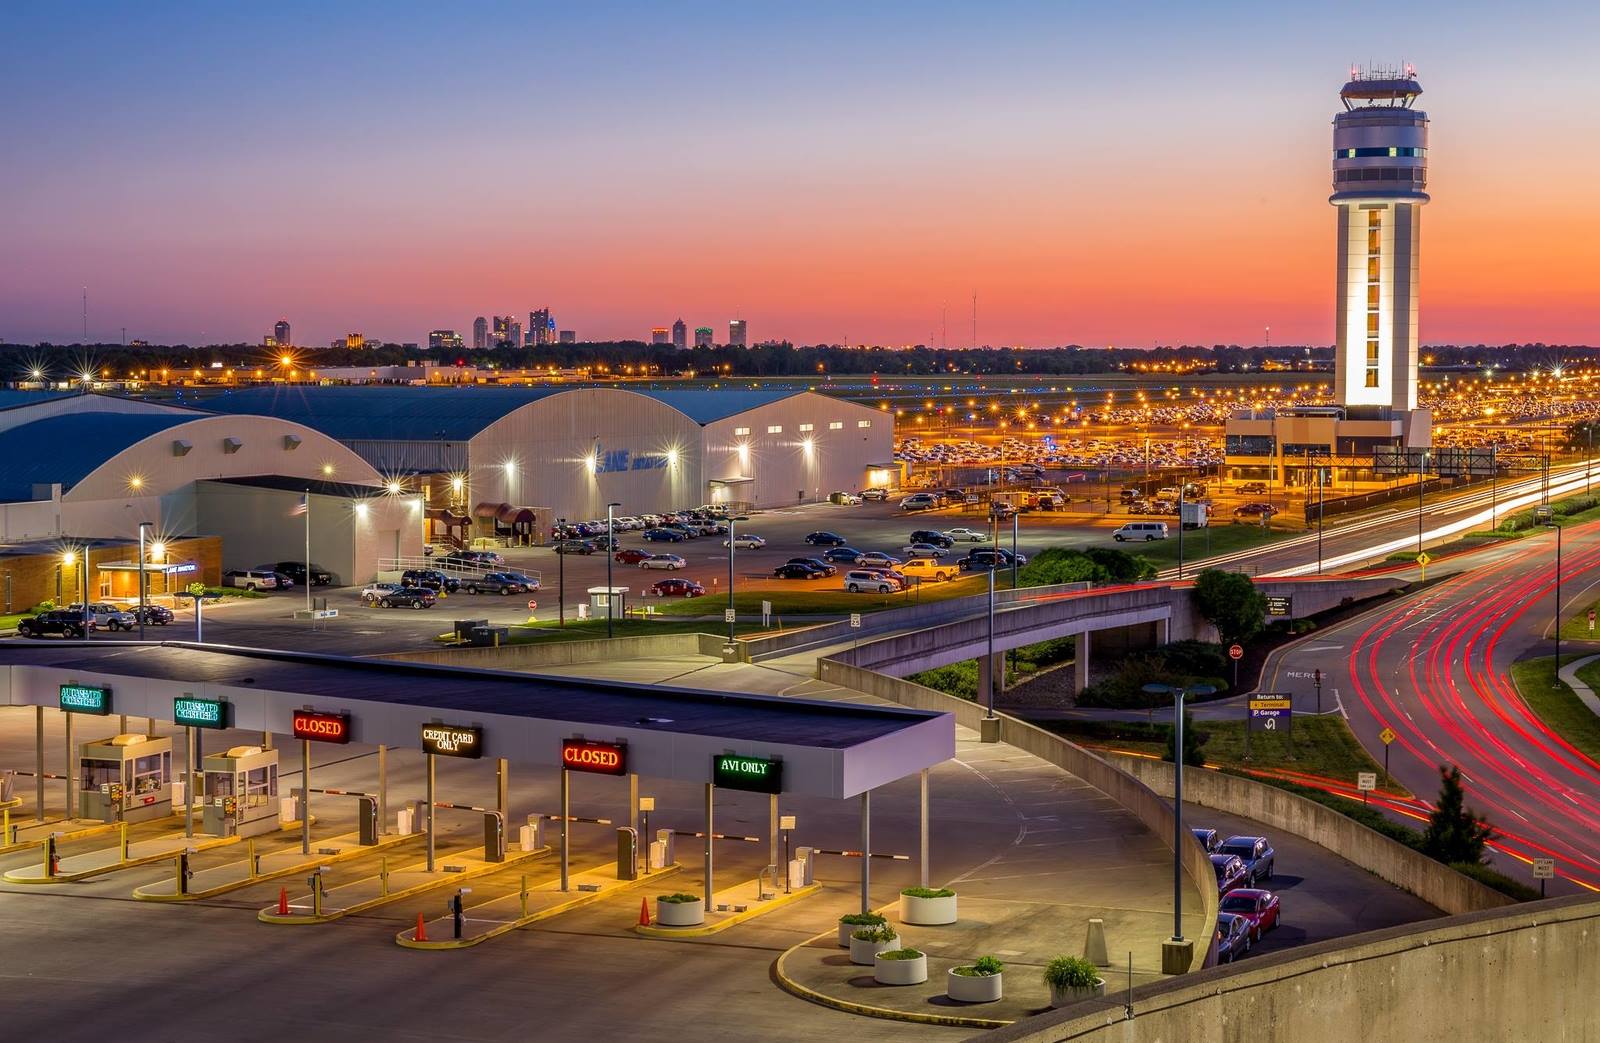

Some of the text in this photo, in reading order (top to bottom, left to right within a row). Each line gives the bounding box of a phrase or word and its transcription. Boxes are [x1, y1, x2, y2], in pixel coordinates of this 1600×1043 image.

[295, 718, 341, 735] CLOSED
[423, 729, 474, 744] CREDIT CARD
[437, 740, 459, 751] ONLY
[564, 747, 618, 766] CLOSED
[721, 759, 767, 774] AVI ONLY
